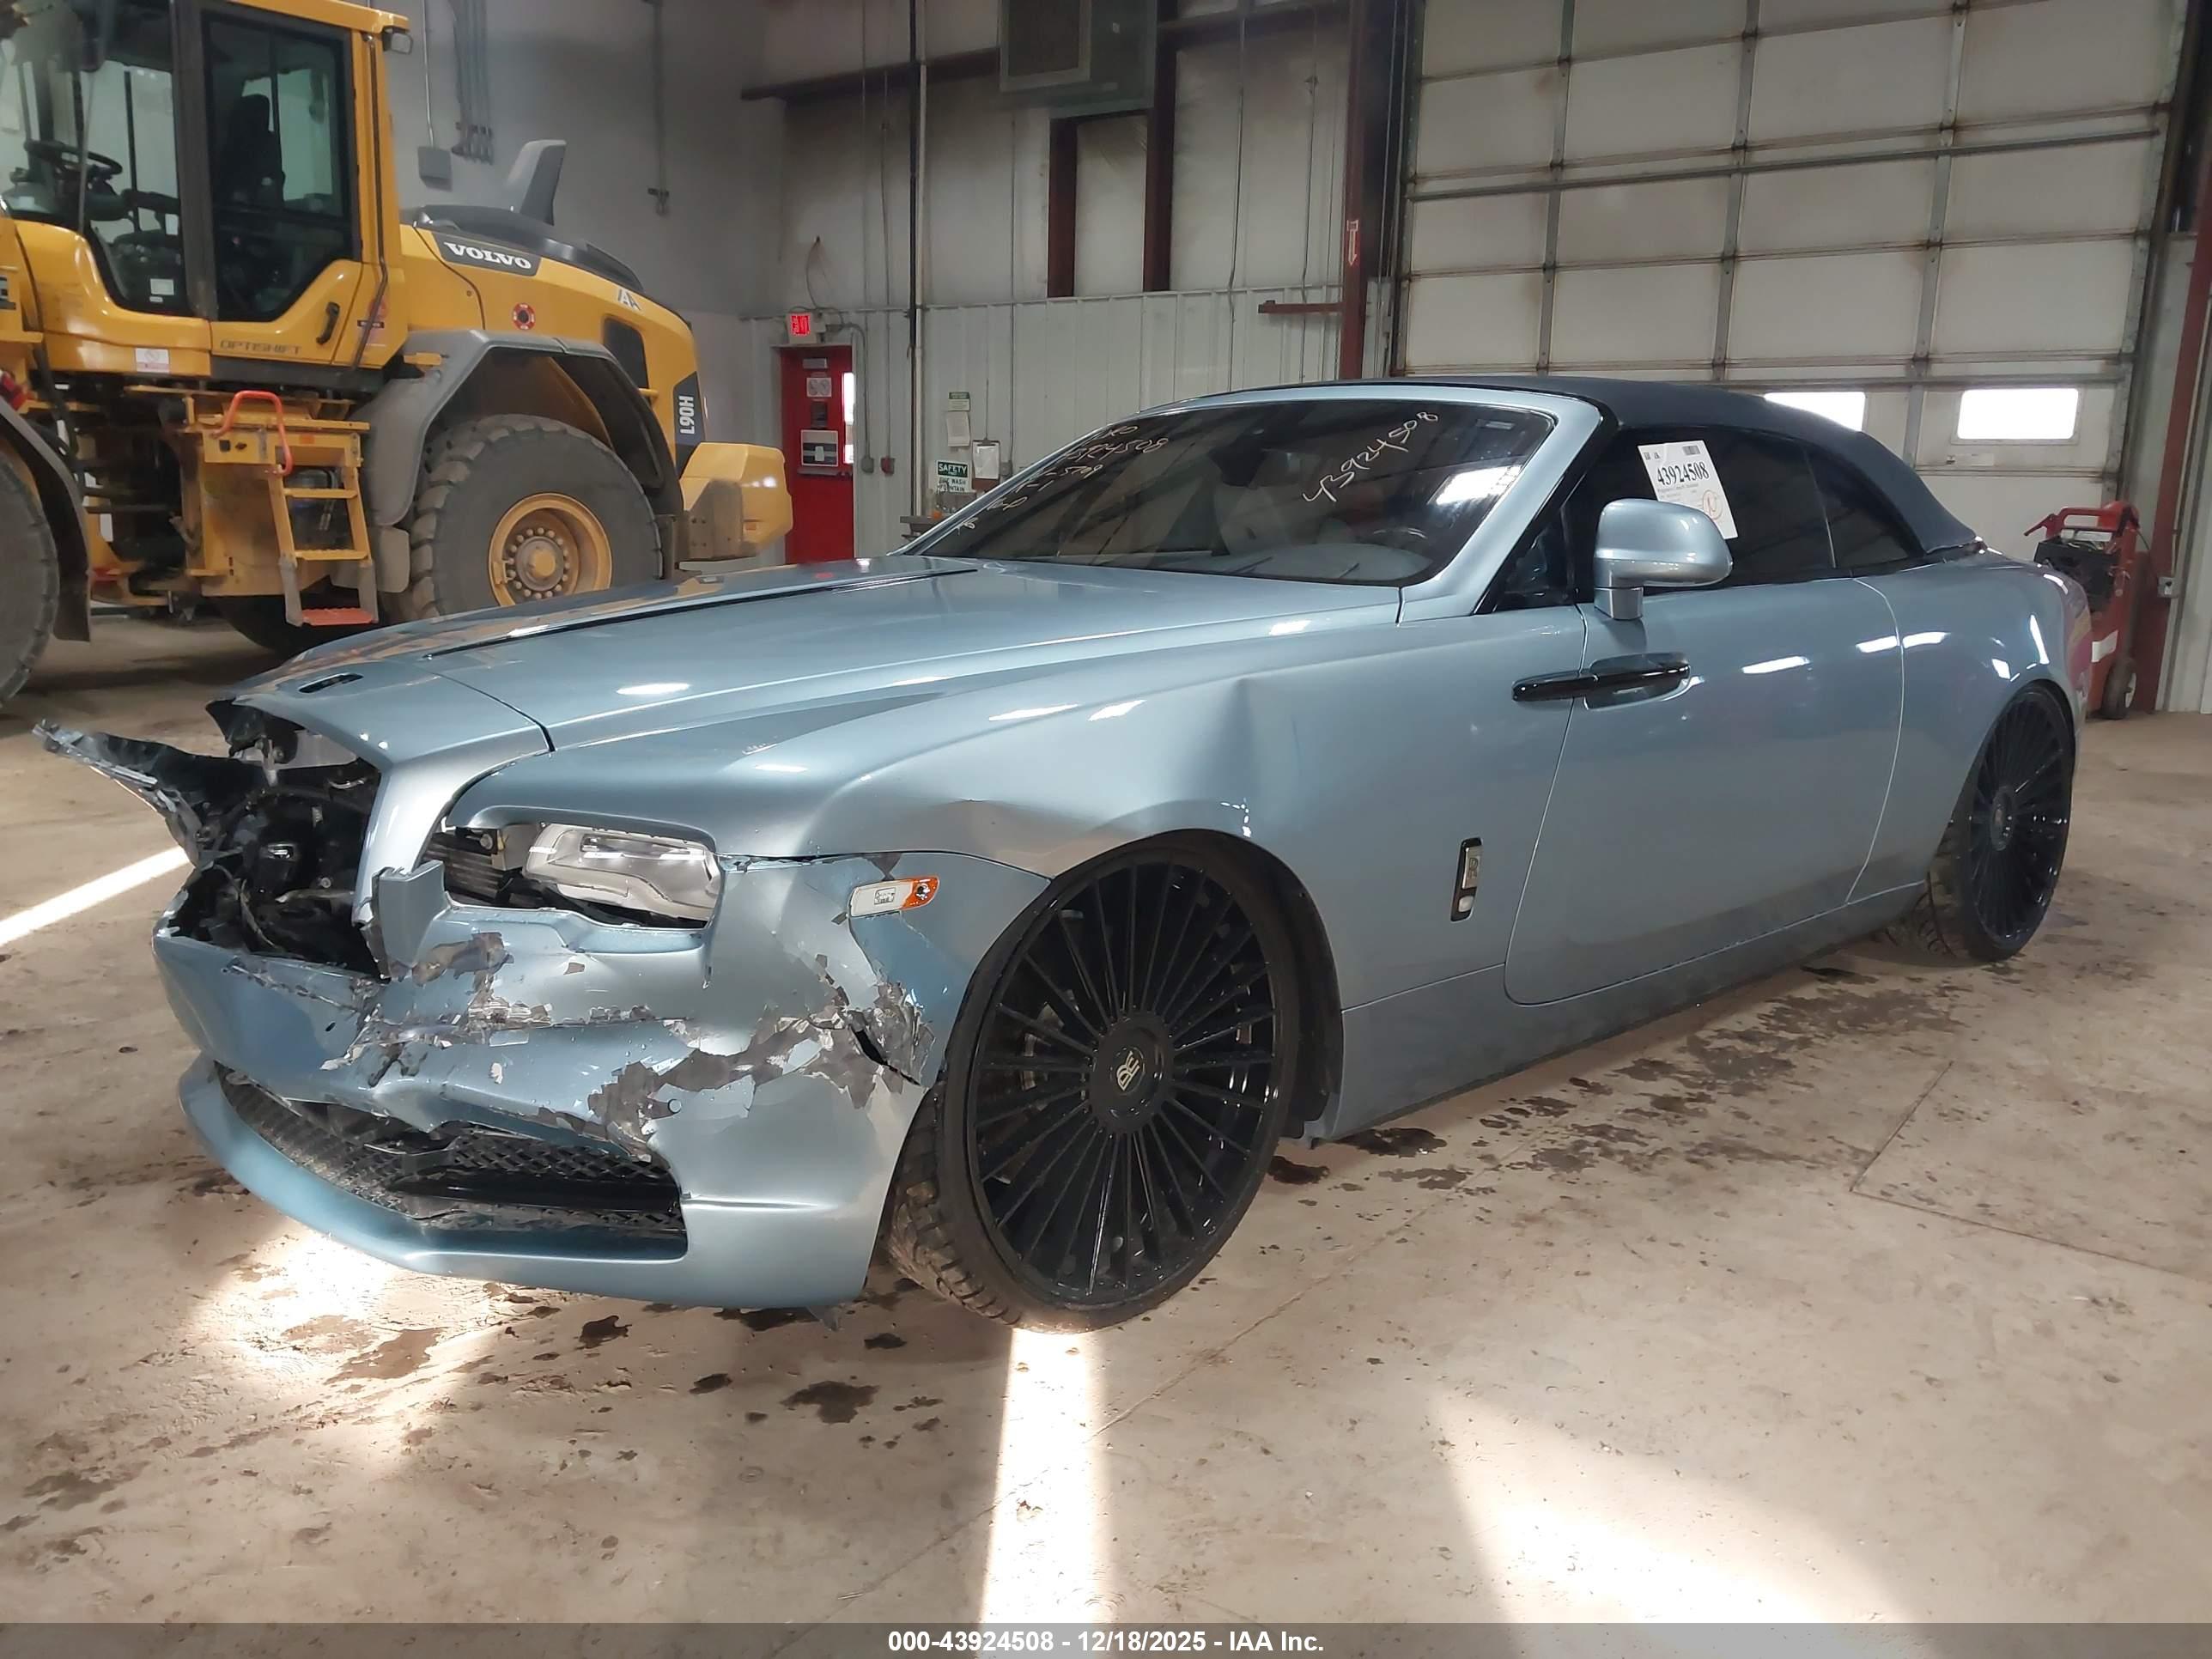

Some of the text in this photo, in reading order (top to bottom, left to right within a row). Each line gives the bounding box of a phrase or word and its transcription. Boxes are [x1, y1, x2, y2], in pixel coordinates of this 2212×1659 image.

[444, 241, 532, 270] VOLVO
[678, 395, 696, 434] L90H
[939, 463, 967, 474] SAFETY
[1657, 461, 1710, 486] 43924508
